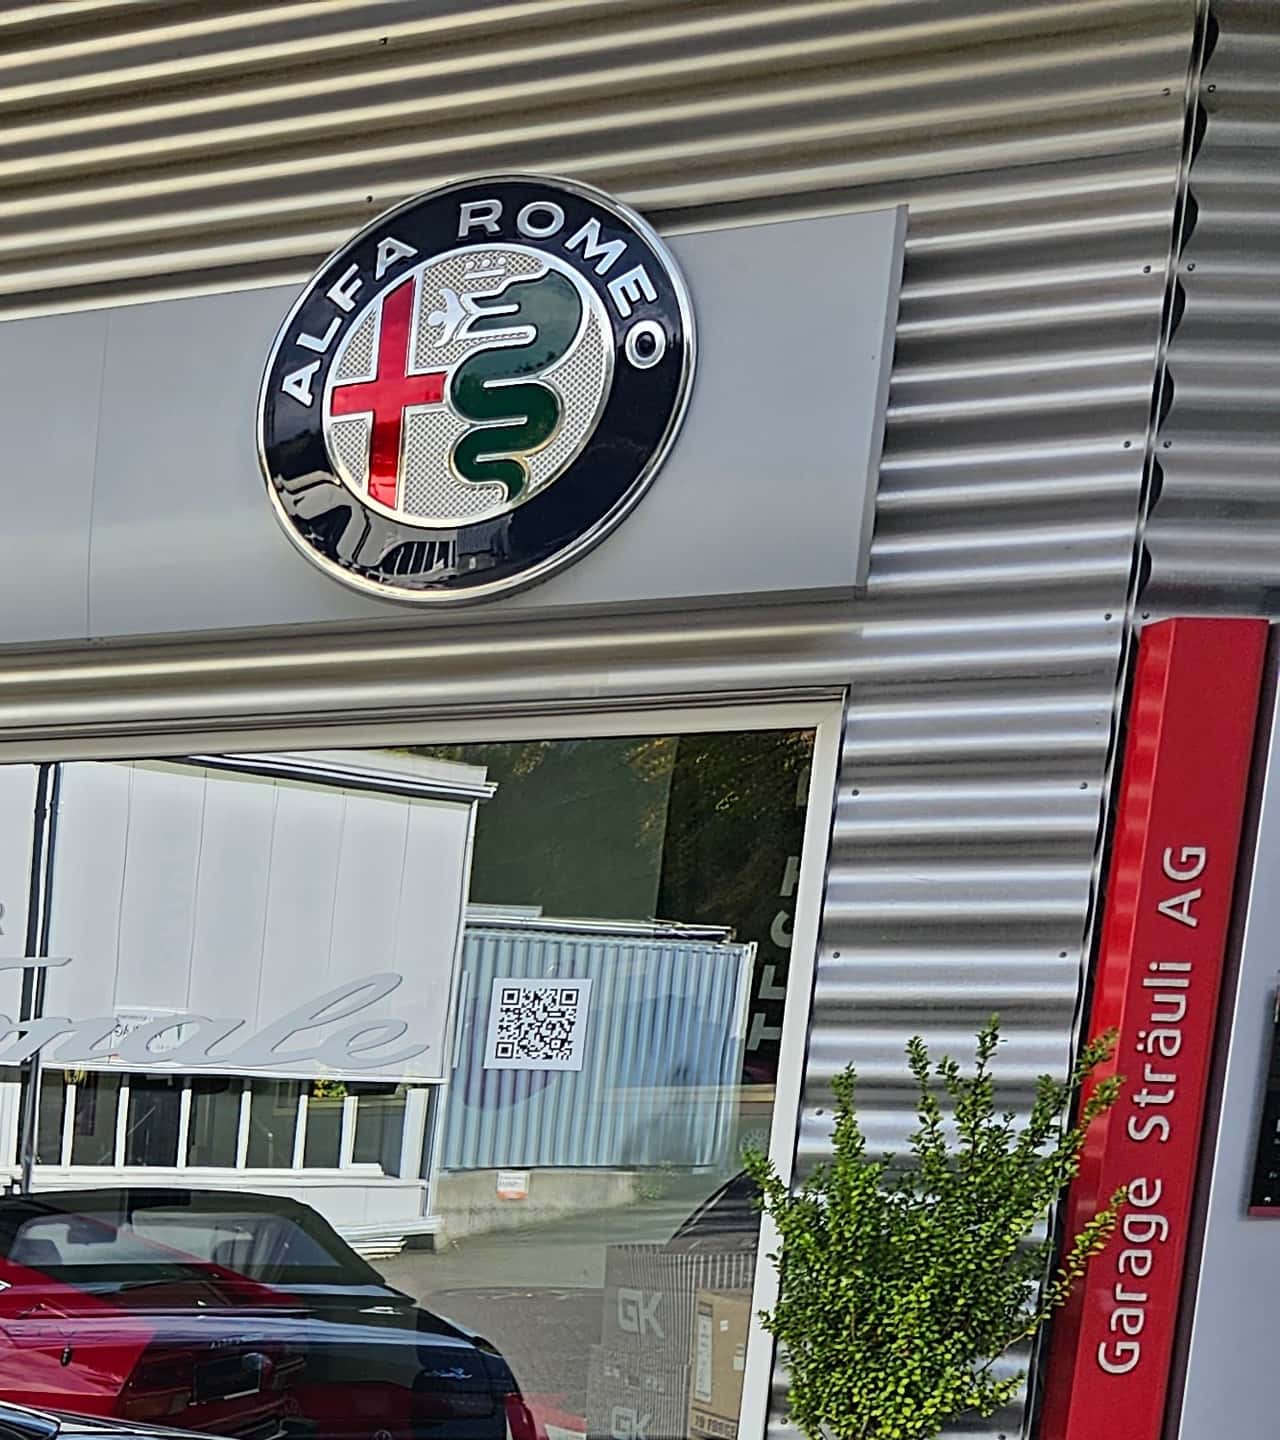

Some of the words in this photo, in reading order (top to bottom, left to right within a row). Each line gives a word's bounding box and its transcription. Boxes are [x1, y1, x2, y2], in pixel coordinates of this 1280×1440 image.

[281, 236, 418, 406] ALFA
[457, 199, 666, 369] ROMEO
[1158, 846, 1207, 929] AG
[1128, 959, 1192, 1143] Sträuli
[617, 1288, 665, 1339] GK
[1098, 1178, 1169, 1373] Garage
